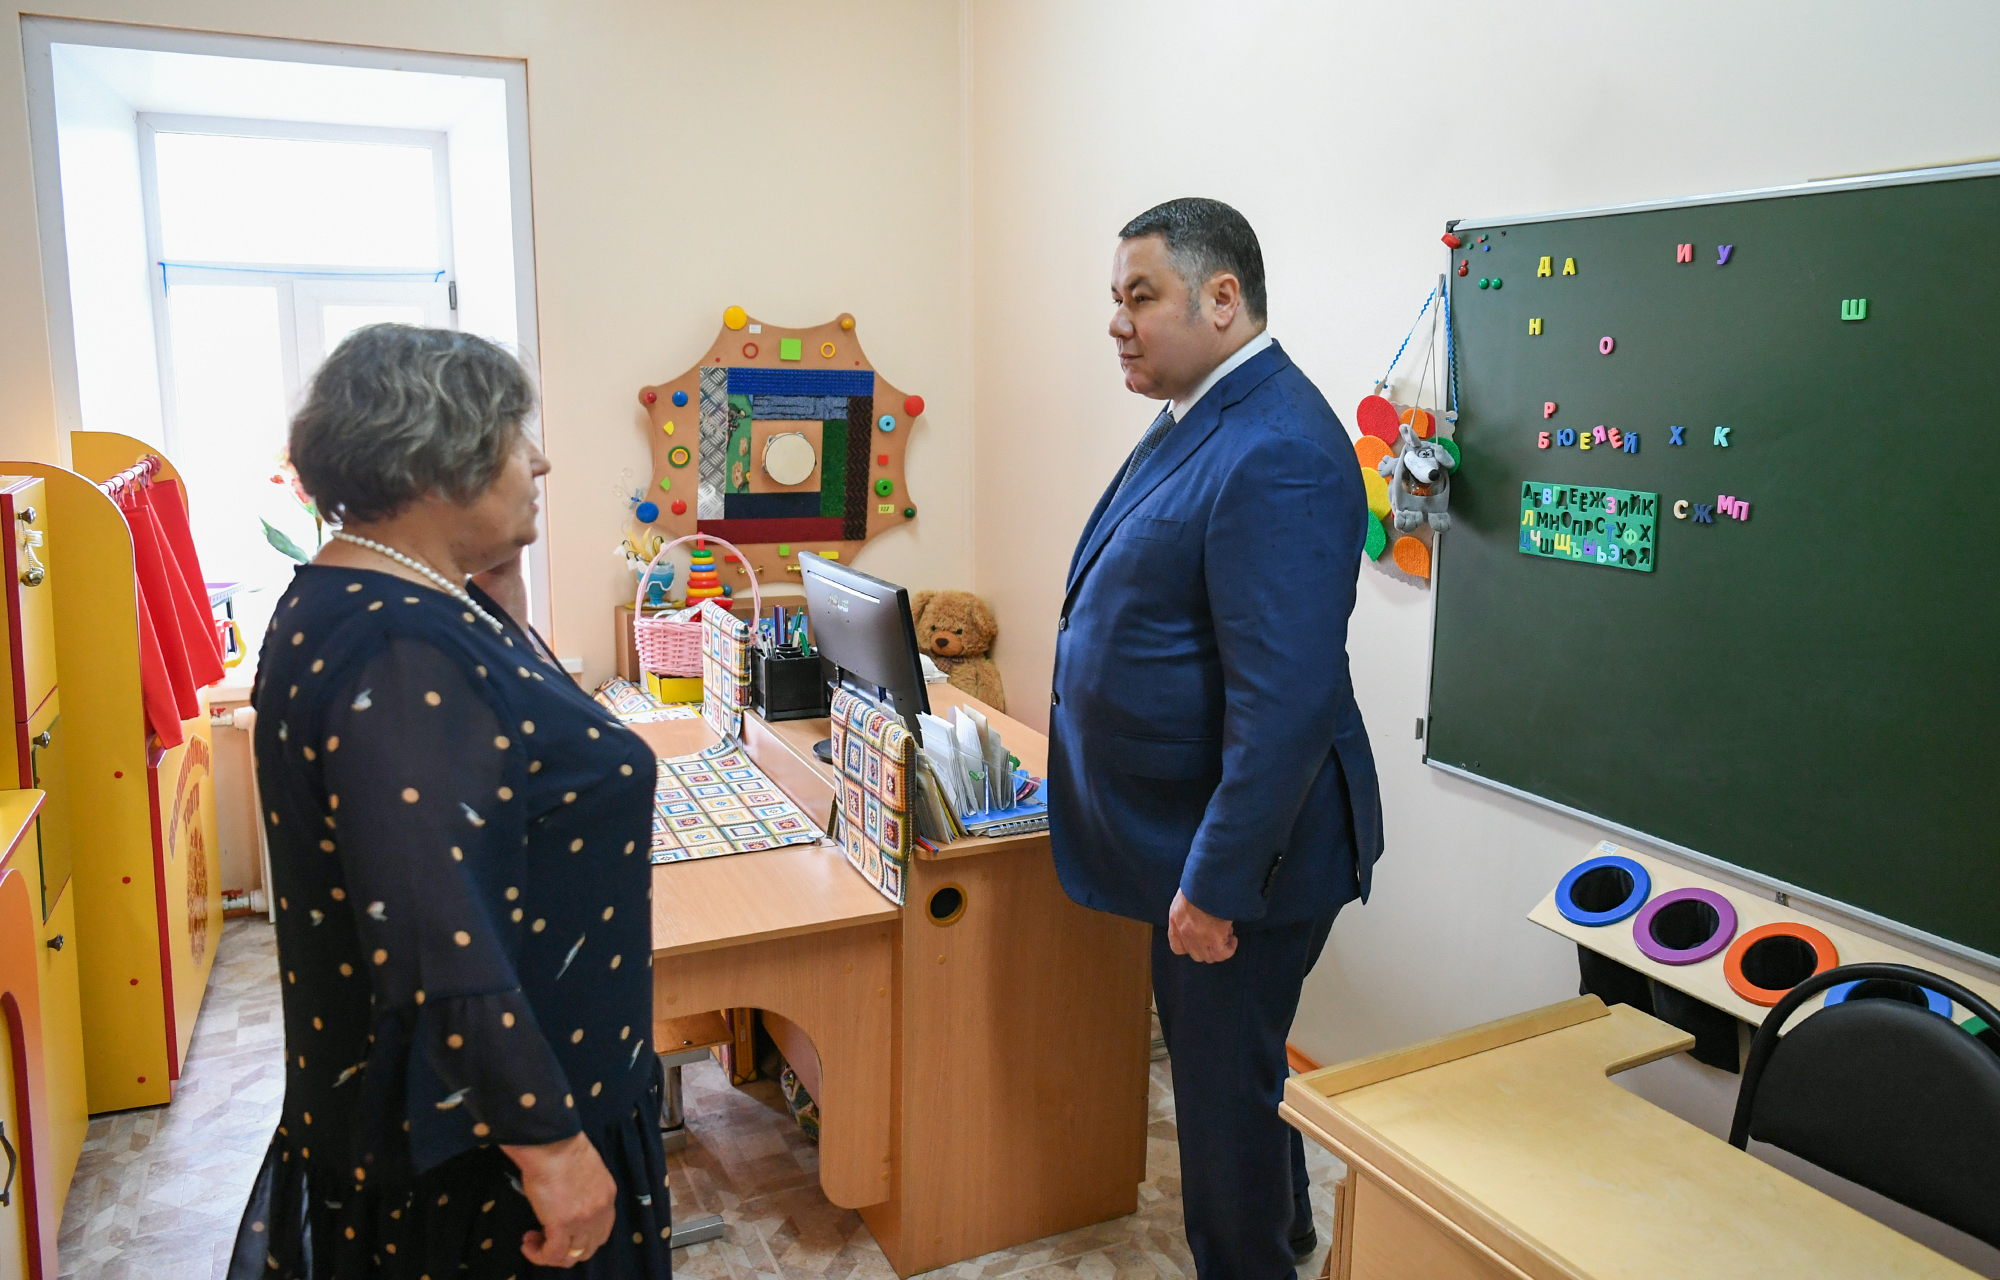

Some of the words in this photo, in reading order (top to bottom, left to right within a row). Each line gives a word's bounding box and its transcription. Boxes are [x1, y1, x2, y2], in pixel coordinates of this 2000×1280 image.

[1841, 299, 1866, 320] Ш
[1529, 318, 1541, 335] Н
[1600, 336, 1614, 354] О
[1544, 402, 1556, 418] Р
[1714, 426, 1730, 447] К
